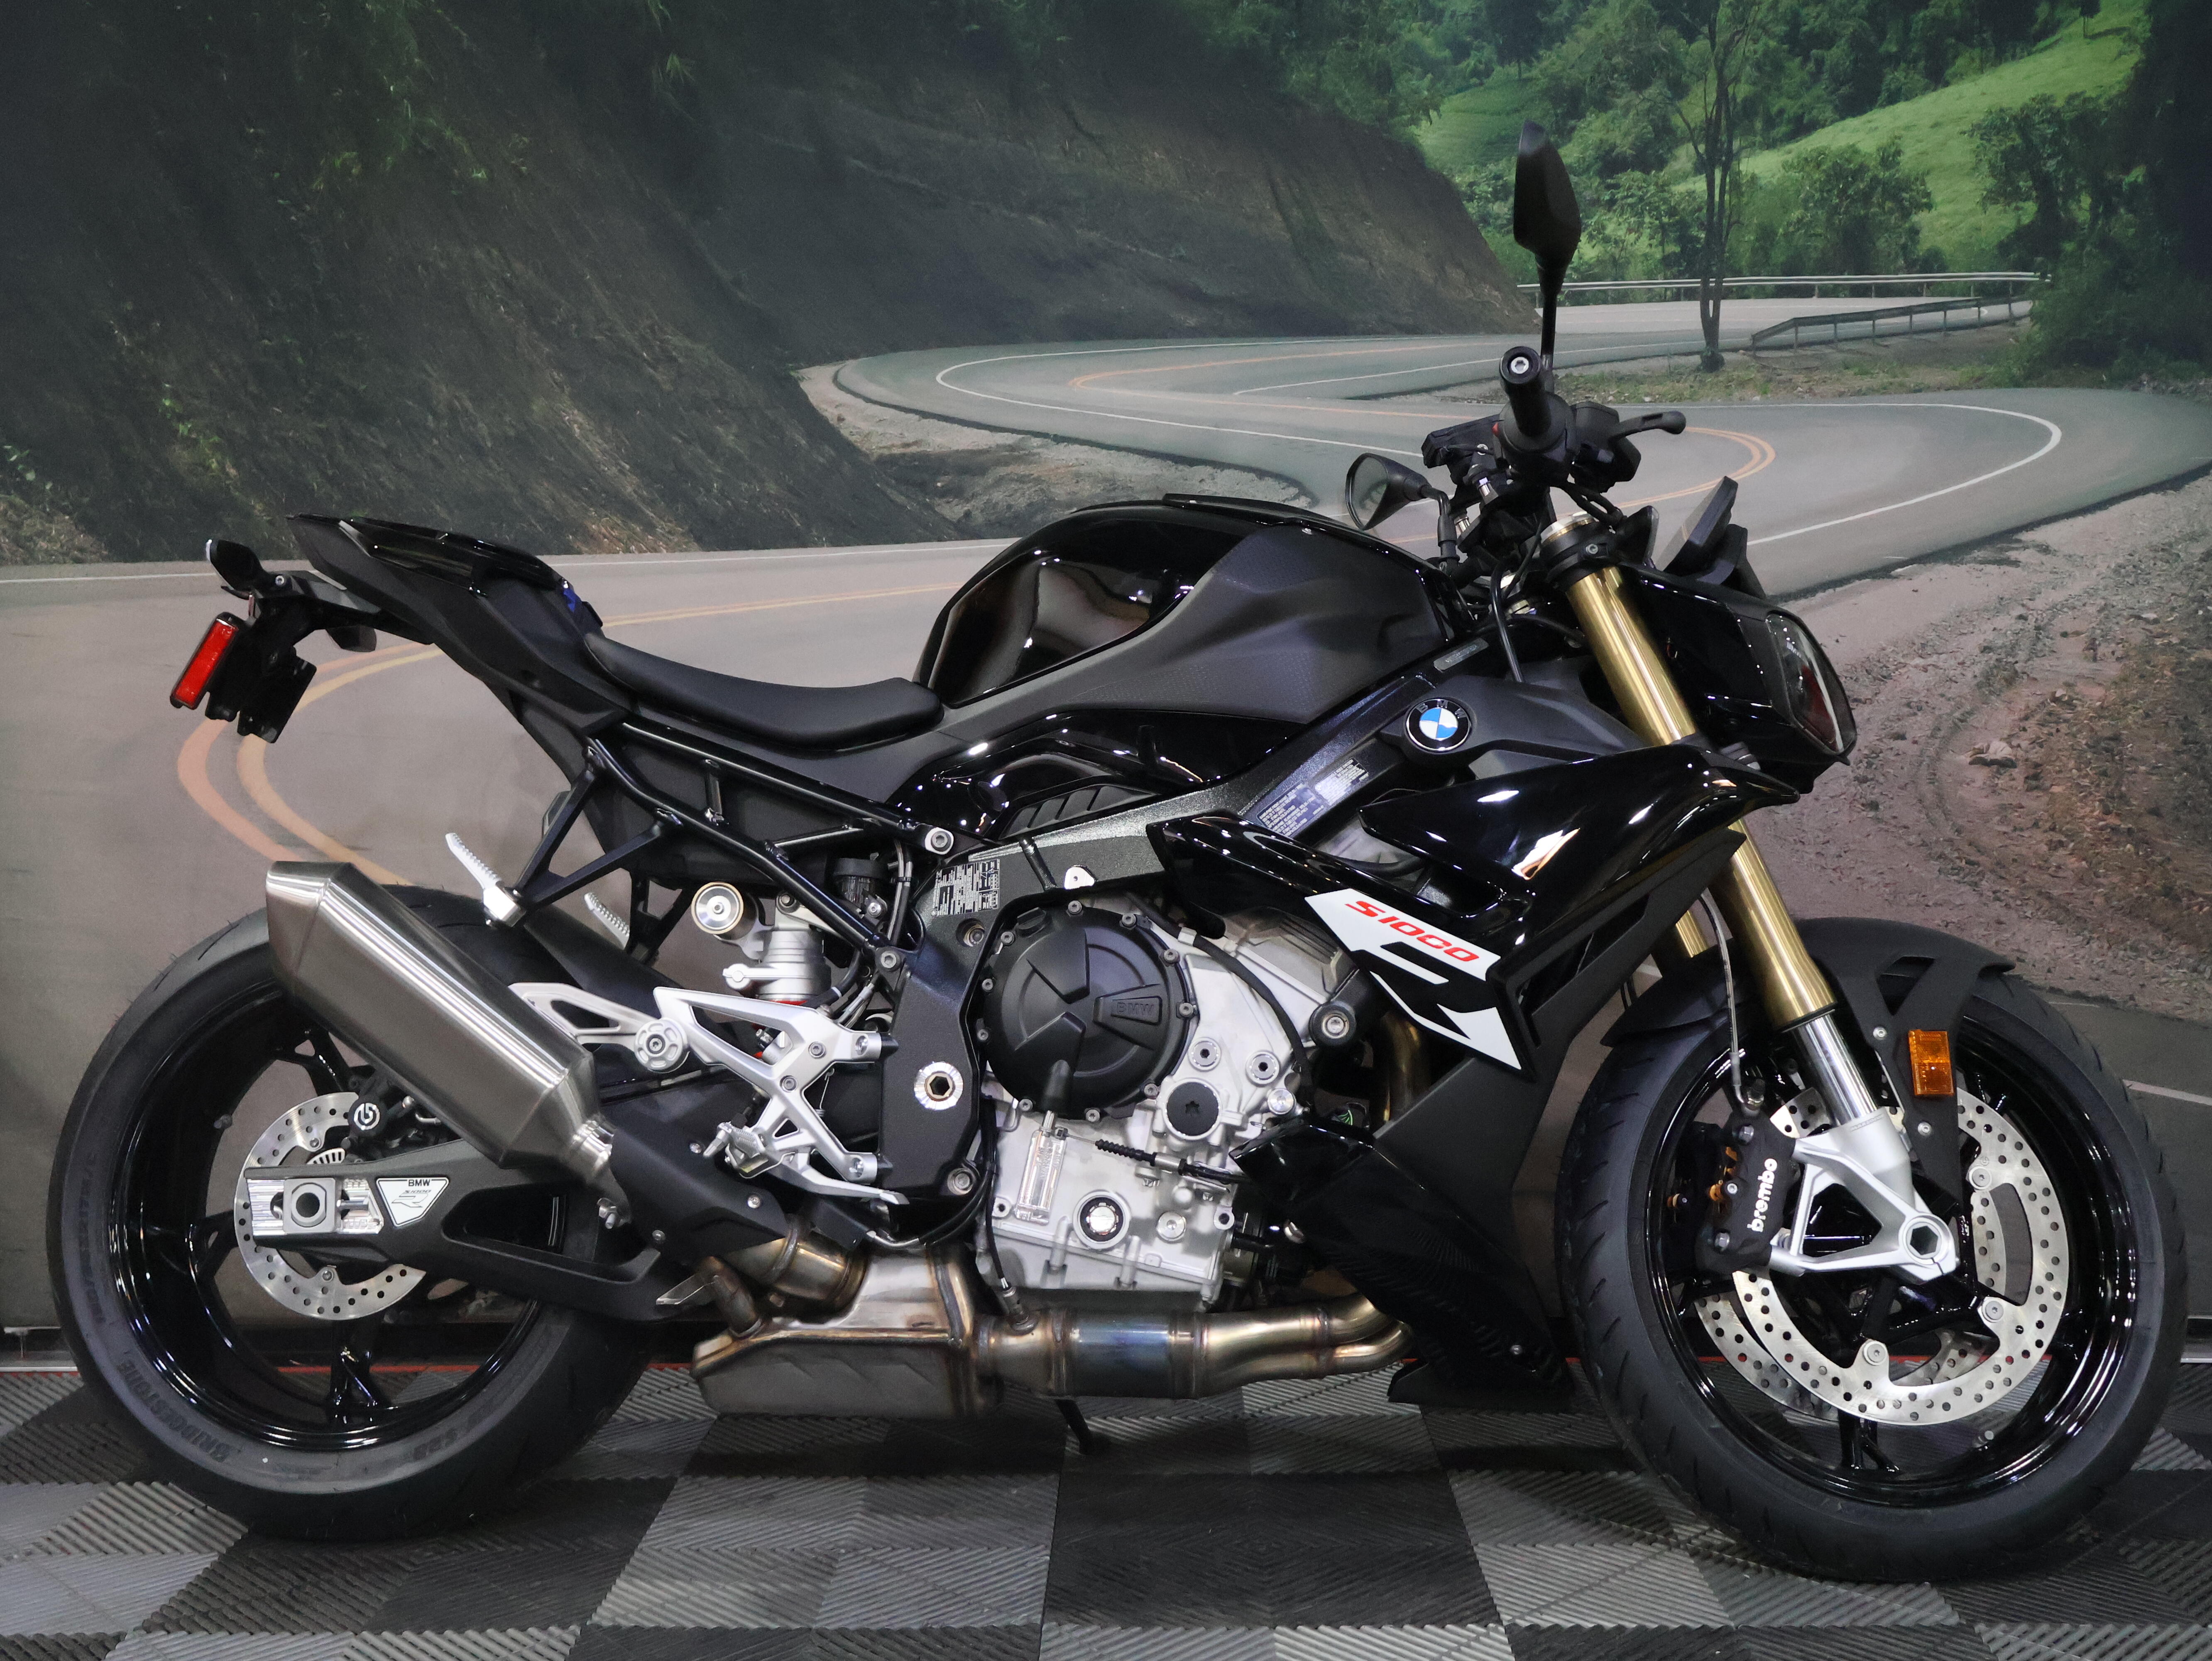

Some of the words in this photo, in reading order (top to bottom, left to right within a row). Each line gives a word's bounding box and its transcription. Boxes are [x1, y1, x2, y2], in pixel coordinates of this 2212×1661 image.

[1416, 701, 1467, 718] BMW
[1344, 900, 1479, 962] S1000
[1117, 1002, 1154, 1016] BMW
[392, 1193, 428, 1208] R
[1747, 1158, 1778, 1232] brembo
